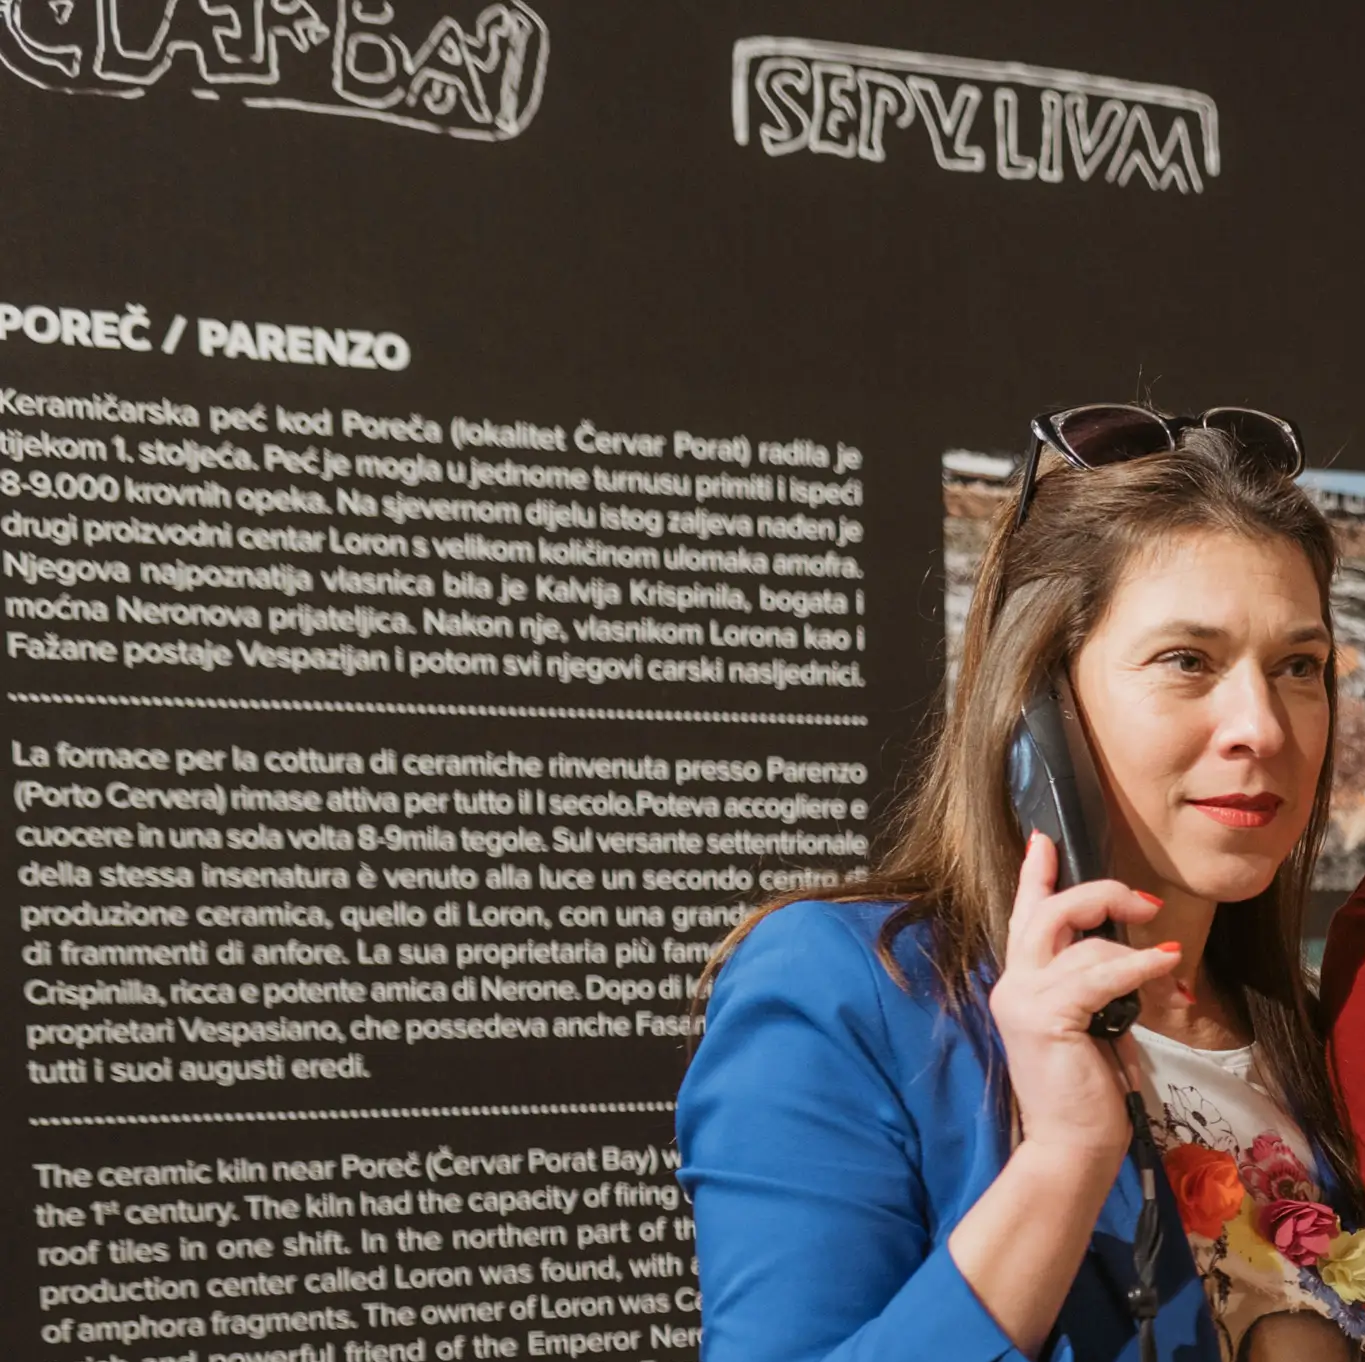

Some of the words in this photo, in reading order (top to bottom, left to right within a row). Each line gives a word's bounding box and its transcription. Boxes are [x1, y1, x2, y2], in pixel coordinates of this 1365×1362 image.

[197, 317, 412, 372] PARENZO
[0, 428, 108, 463] tijekom
[355, 452, 444, 487] mogla
[468, 456, 591, 491] jednome
[592, 465, 692, 497] turnusu
[673, 430, 752, 468] Porat)
[0, 468, 121, 503] 8-9.000
[124, 475, 233, 509] krovnih
[0, 509, 79, 546] drugi
[82, 516, 234, 549] proizvodni
[236, 525, 326, 553] centar
[328, 525, 409, 558] Loron
[431, 532, 536, 563] velikom
[2, 549, 131, 587] Njegova
[320, 565, 436, 597] vlasnica
[759, 584, 849, 619] bogata
[116, 595, 263, 629] Neronova
[422, 607, 514, 638] Nakon
[572, 614, 705, 646] vlasnikom
[709, 619, 799, 649] Lorona
[123, 639, 234, 672] postaje
[235, 639, 391, 677] Vespazijan
[408, 648, 499, 678] potom
[546, 651, 644, 685] njegovi
[647, 655, 725, 683] carski
[55, 740, 170, 771] fornace
[264, 747, 365, 774] cottura
[401, 750, 544, 779] ceramiche
[548, 752, 670, 781] rinvenuta
[675, 759, 763, 786] presso
[766, 755, 868, 785] Parenzo
[13, 780, 103, 813] (Porto
[105, 781, 228, 816] Cervera)
[230, 784, 323, 812] rimase
[326, 786, 401, 813] attiva
[452, 789, 515, 815] tutto
[724, 793, 848, 825] accogliere
[15, 825, 134, 848] cuocere
[286, 823, 354, 851] volta
[357, 823, 458, 852] 8-9mila
[459, 825, 549, 858] tegole.
[595, 829, 704, 855] versante
[706, 829, 869, 861] settentrionale
[17, 860, 93, 887] della
[98, 862, 195, 888] stessa
[201, 862, 351, 889] insenatura
[382, 864, 479, 890] venuto
[642, 865, 754, 891] secondo
[20, 900, 189, 932] produzione
[195, 900, 334, 930] ceramica,
[339, 900, 427, 932] quello
[467, 900, 553, 930] Loron,
[59, 939, 209, 966] frammenti
[251, 938, 351, 966] anfore.
[455, 938, 608, 970] proprietaria
[23, 978, 168, 1010] Crispinilla,
[170, 978, 236, 1005] ricca
[263, 978, 368, 1009] potente
[370, 976, 449, 1003] amica
[480, 975, 582, 1002] Nerone.
[26, 1017, 175, 1050] proprietari
[177, 1016, 347, 1048] Vespasiano,
[405, 1012, 549, 1045] possedeva
[552, 1011, 632, 1038] anche
[26, 1058, 88, 1084] tutti
[179, 1054, 285, 1086] augusti
[290, 1052, 371, 1080] eredi.
[97, 1159, 212, 1188] ceramic
[216, 1157, 267, 1183] kiln
[527, 1148, 598, 1173] Porat
[124, 1199, 240, 1227] century.
[305, 1192, 355, 1218] kiln
[467, 1185, 579, 1217] capacity
[613, 1181, 679, 1211] firing
[108, 1238, 170, 1264] tiles
[283, 1229, 351, 1257] shift.
[452, 1222, 568, 1250] northern
[39, 1276, 199, 1311] production
[206, 1272, 298, 1298] center
[304, 1265, 388, 1294] called
[394, 1264, 473, 1289] Loron
[540, 1254, 623, 1283] found,
[628, 1251, 683, 1278] with
[77, 1314, 206, 1346] amphora
[210, 1306, 358, 1340] fragments.
[420, 1301, 505, 1325] owner
[540, 1294, 615, 1319] Loron
[527, 1330, 641, 1359] Emperor
